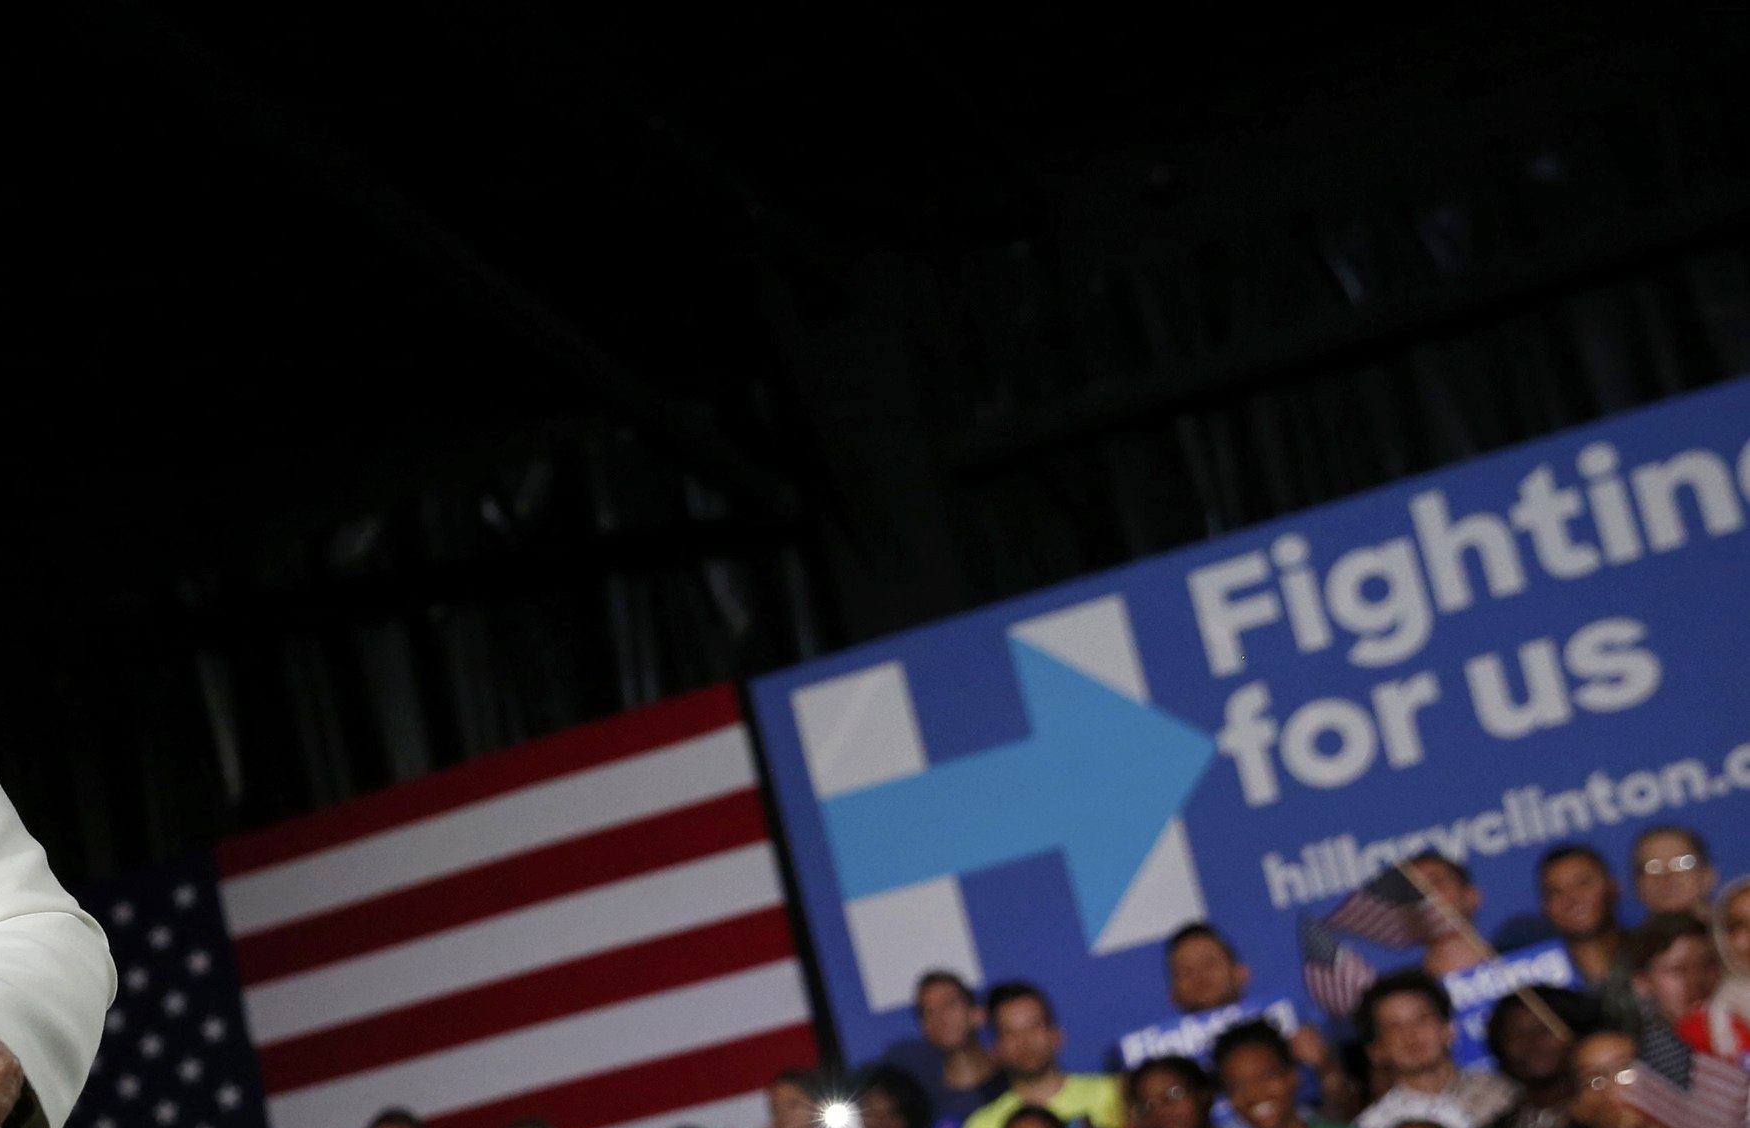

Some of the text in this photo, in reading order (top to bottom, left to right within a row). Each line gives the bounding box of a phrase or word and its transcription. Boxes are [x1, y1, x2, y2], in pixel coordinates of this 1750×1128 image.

[1187, 440, 1750, 680] Fightin
[1217, 615, 1662, 808] for us
